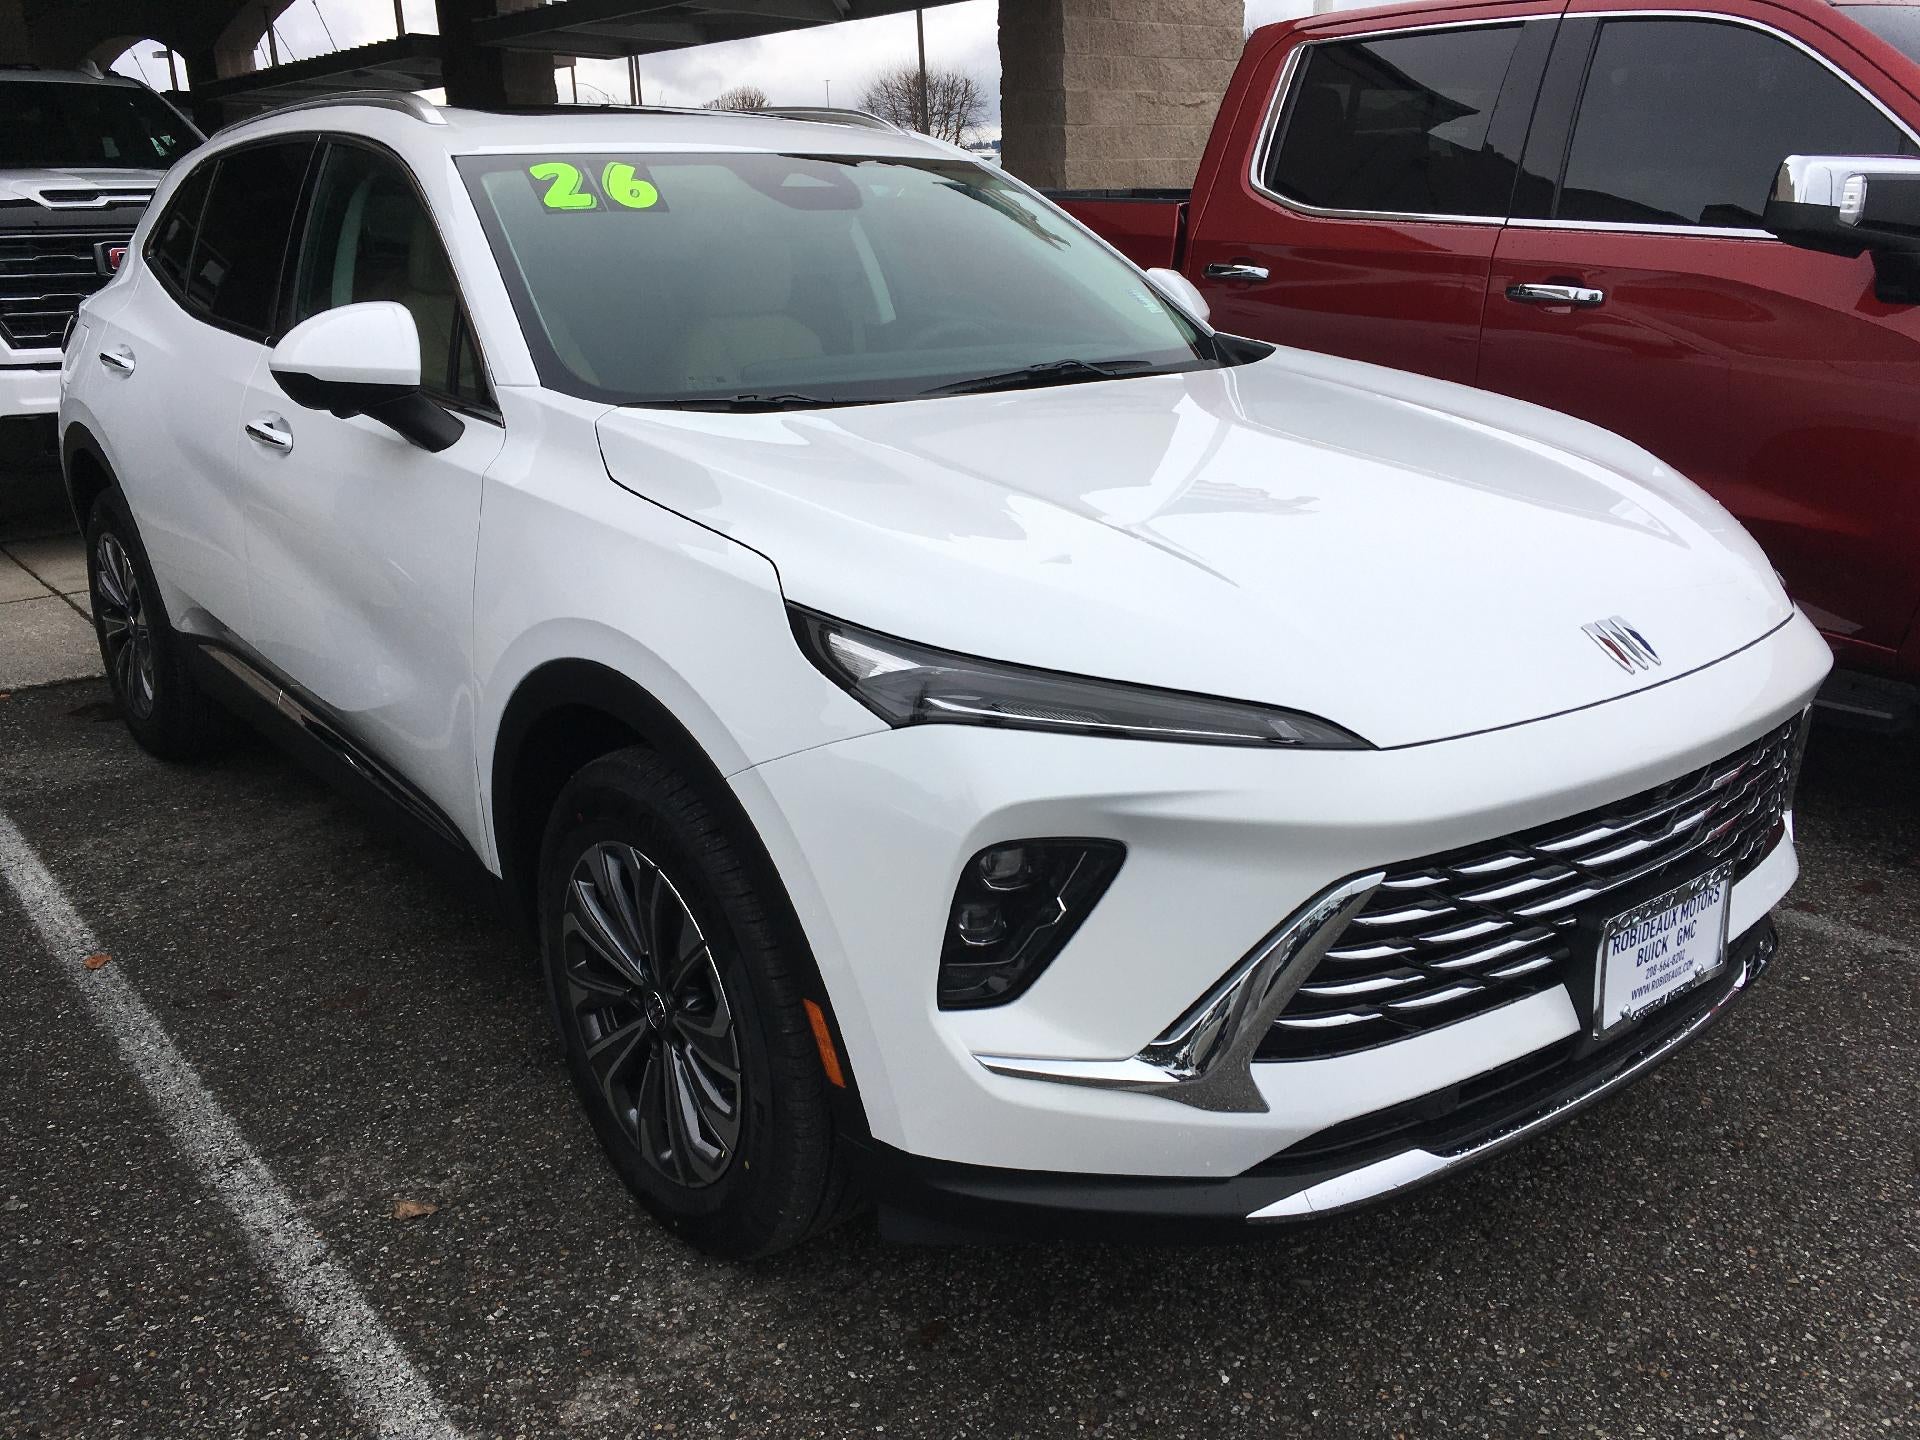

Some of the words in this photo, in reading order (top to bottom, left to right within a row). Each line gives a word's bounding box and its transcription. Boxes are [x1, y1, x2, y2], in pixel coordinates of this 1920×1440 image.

[529, 161, 658, 209] 26
[1612, 907, 1679, 956] ROBIDEAUX
[1681, 884, 1720, 923] MOTORS
[1636, 934, 1669, 967] BUICK
[1676, 919, 1697, 947] GMC
